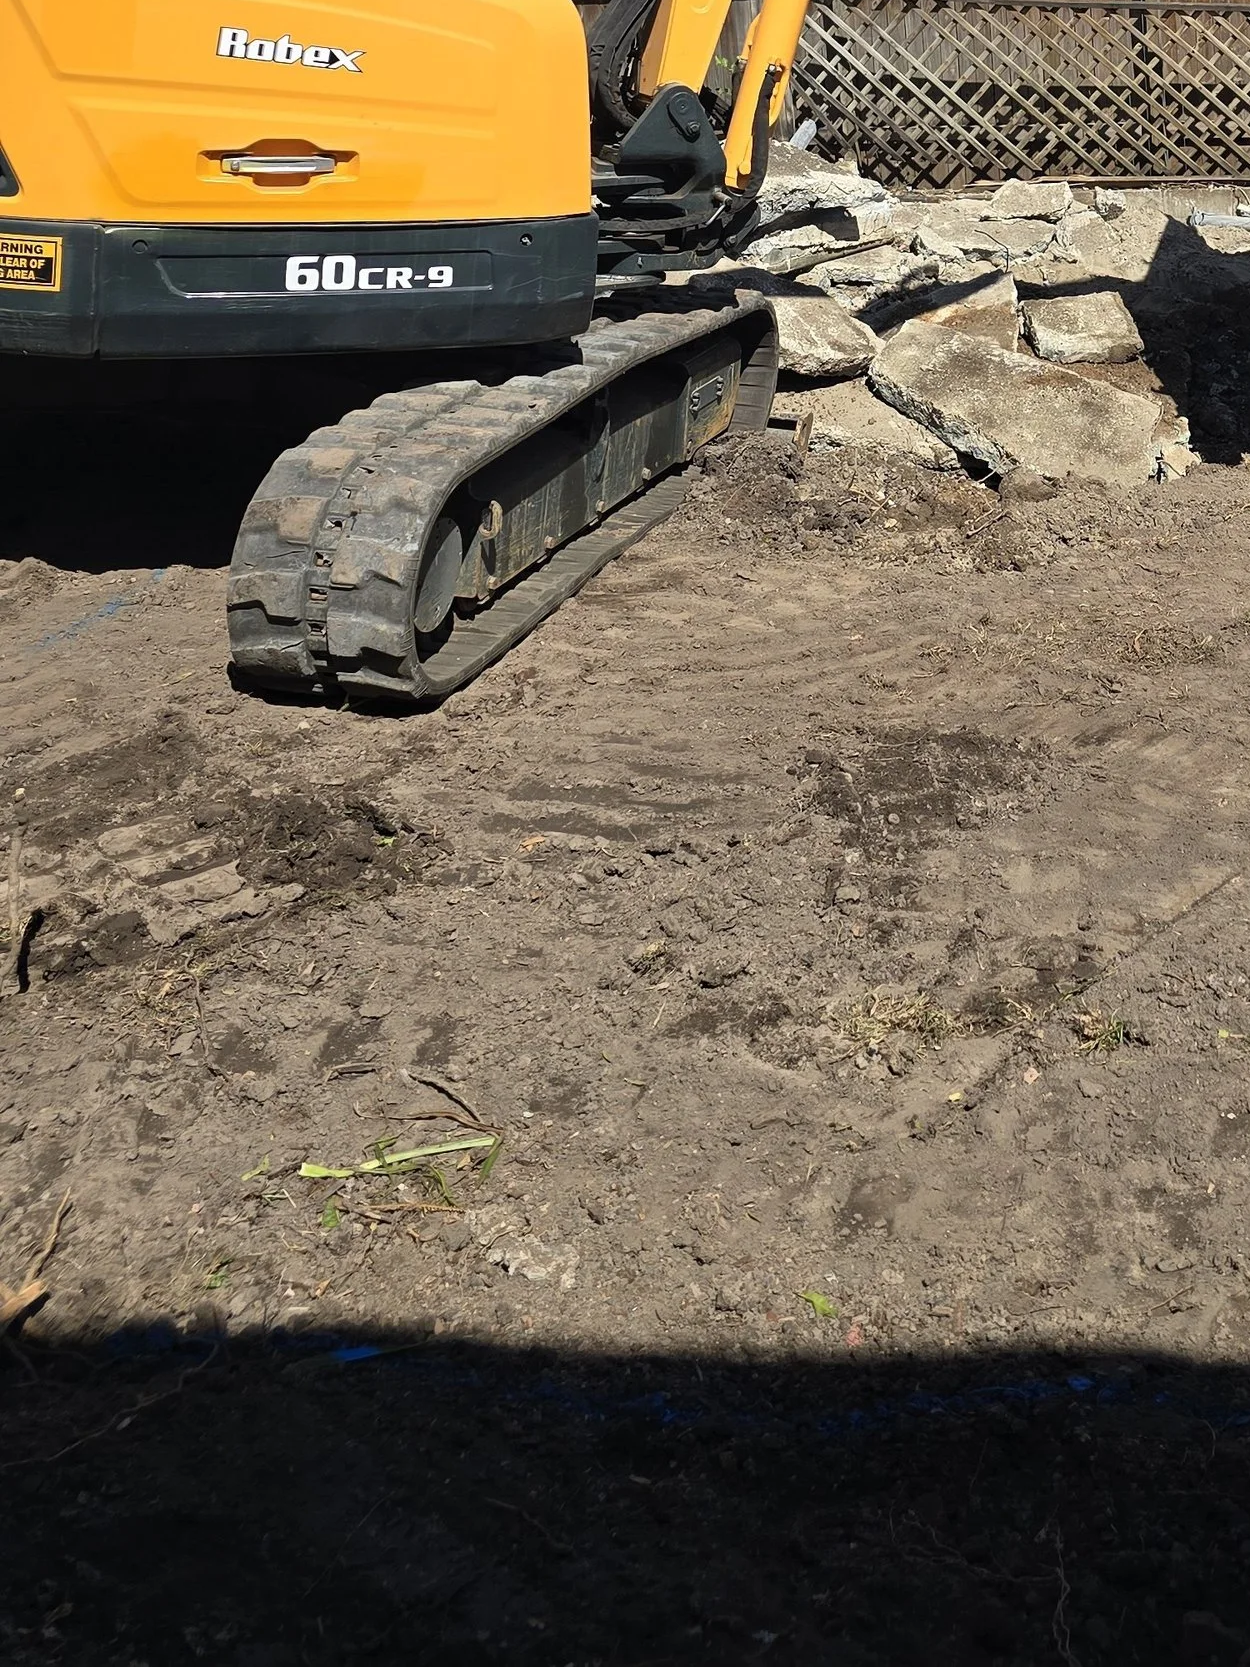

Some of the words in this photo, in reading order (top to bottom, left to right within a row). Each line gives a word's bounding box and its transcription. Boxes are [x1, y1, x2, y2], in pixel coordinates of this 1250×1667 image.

[216, 26, 367, 73] Robex
[6, 269, 36, 280] AREA
[29, 259, 46, 269] OF
[285, 254, 454, 292] 60CR-9
